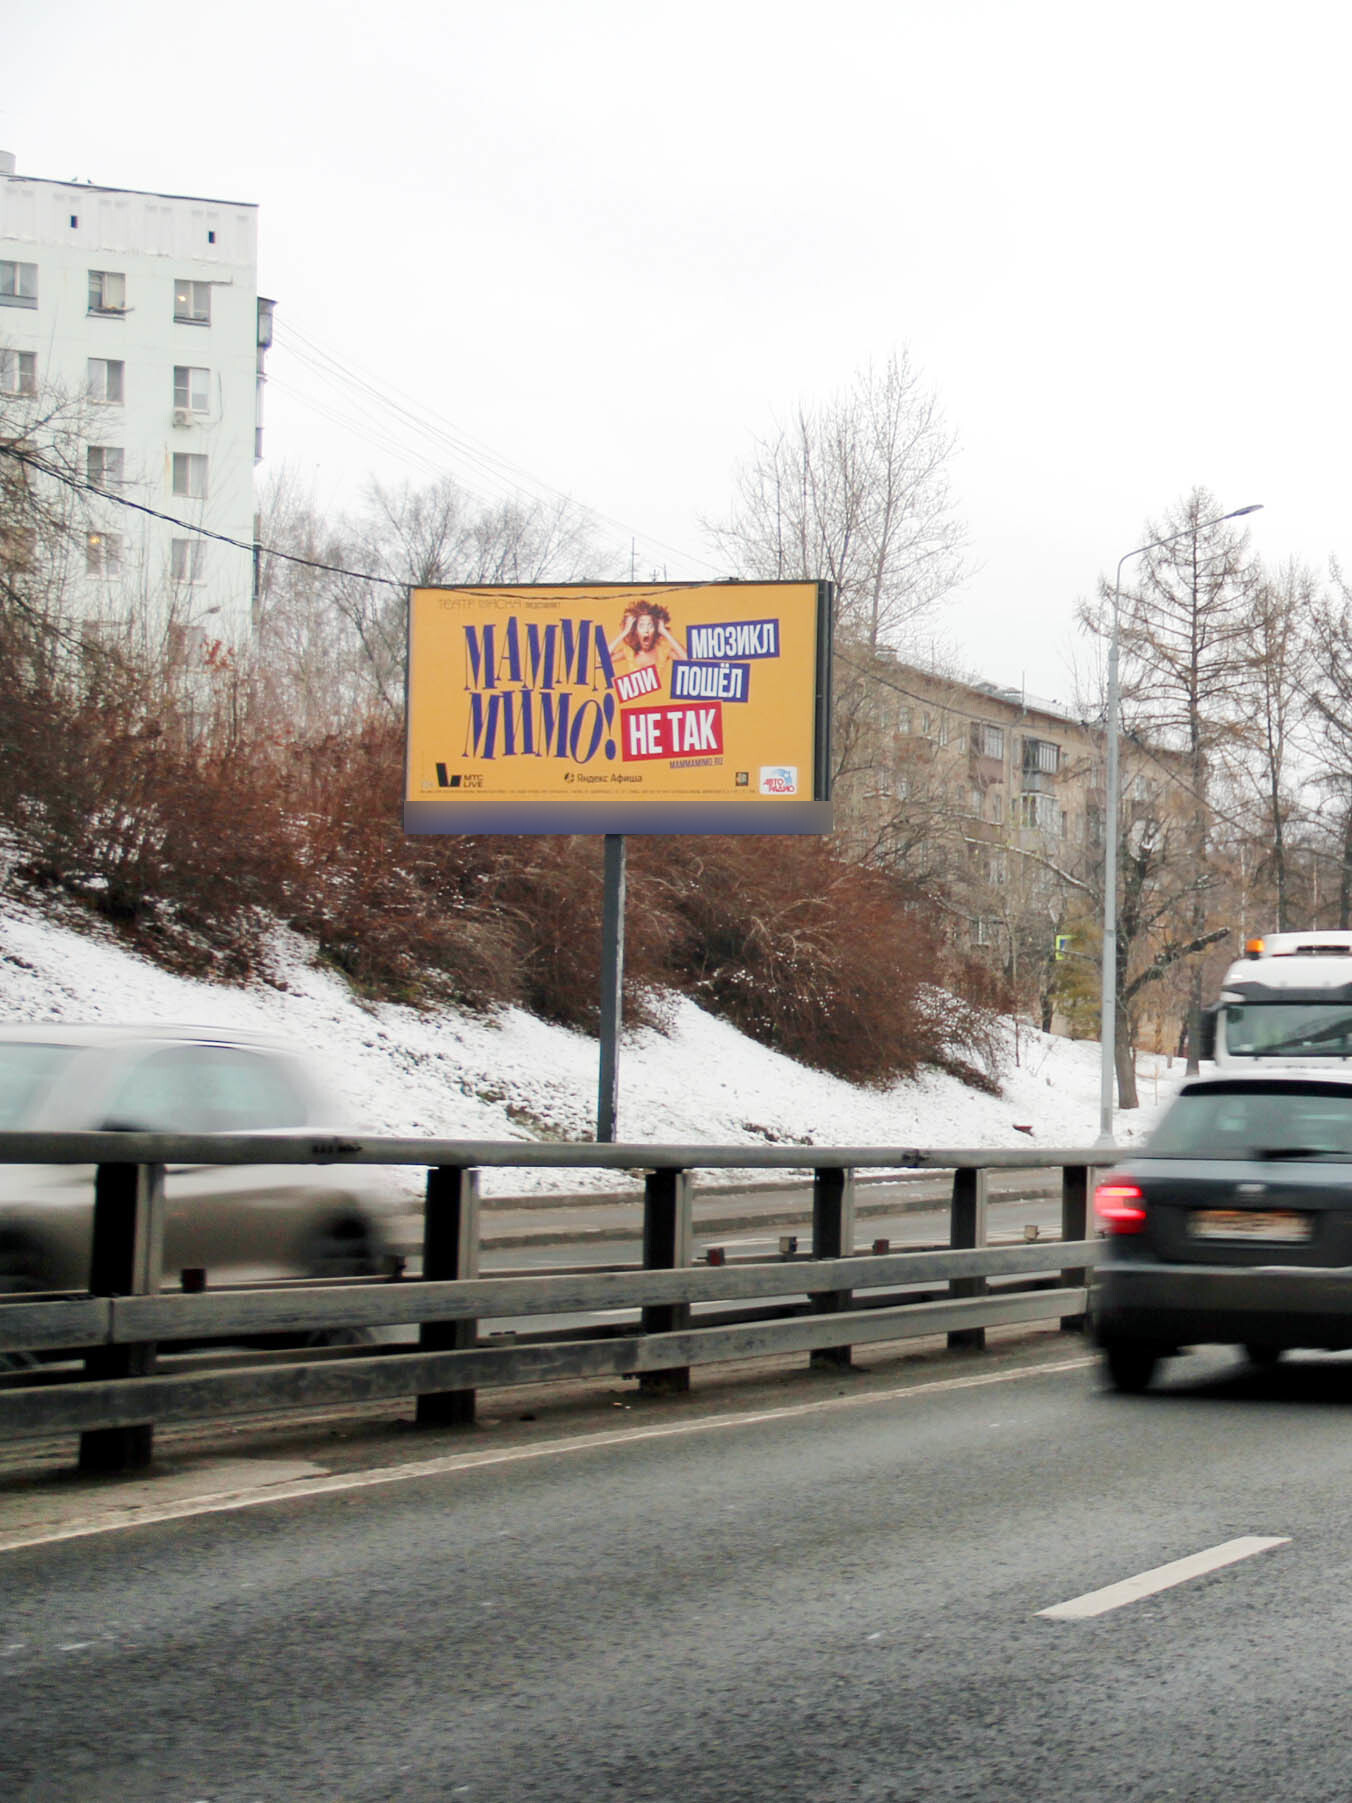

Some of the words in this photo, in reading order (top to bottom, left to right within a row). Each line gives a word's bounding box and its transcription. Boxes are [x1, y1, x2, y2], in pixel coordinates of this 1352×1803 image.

[462, 616, 615, 691] МАММА
[691, 623, 775, 659] МЮЗИКЛ
[617, 667, 658, 700] ИЛИ
[675, 663, 743, 699] ПОШЁЛ
[461, 689, 617, 764] МИМО!
[629, 713, 663, 756] НЕ
[667, 709, 718, 752] ТАК
